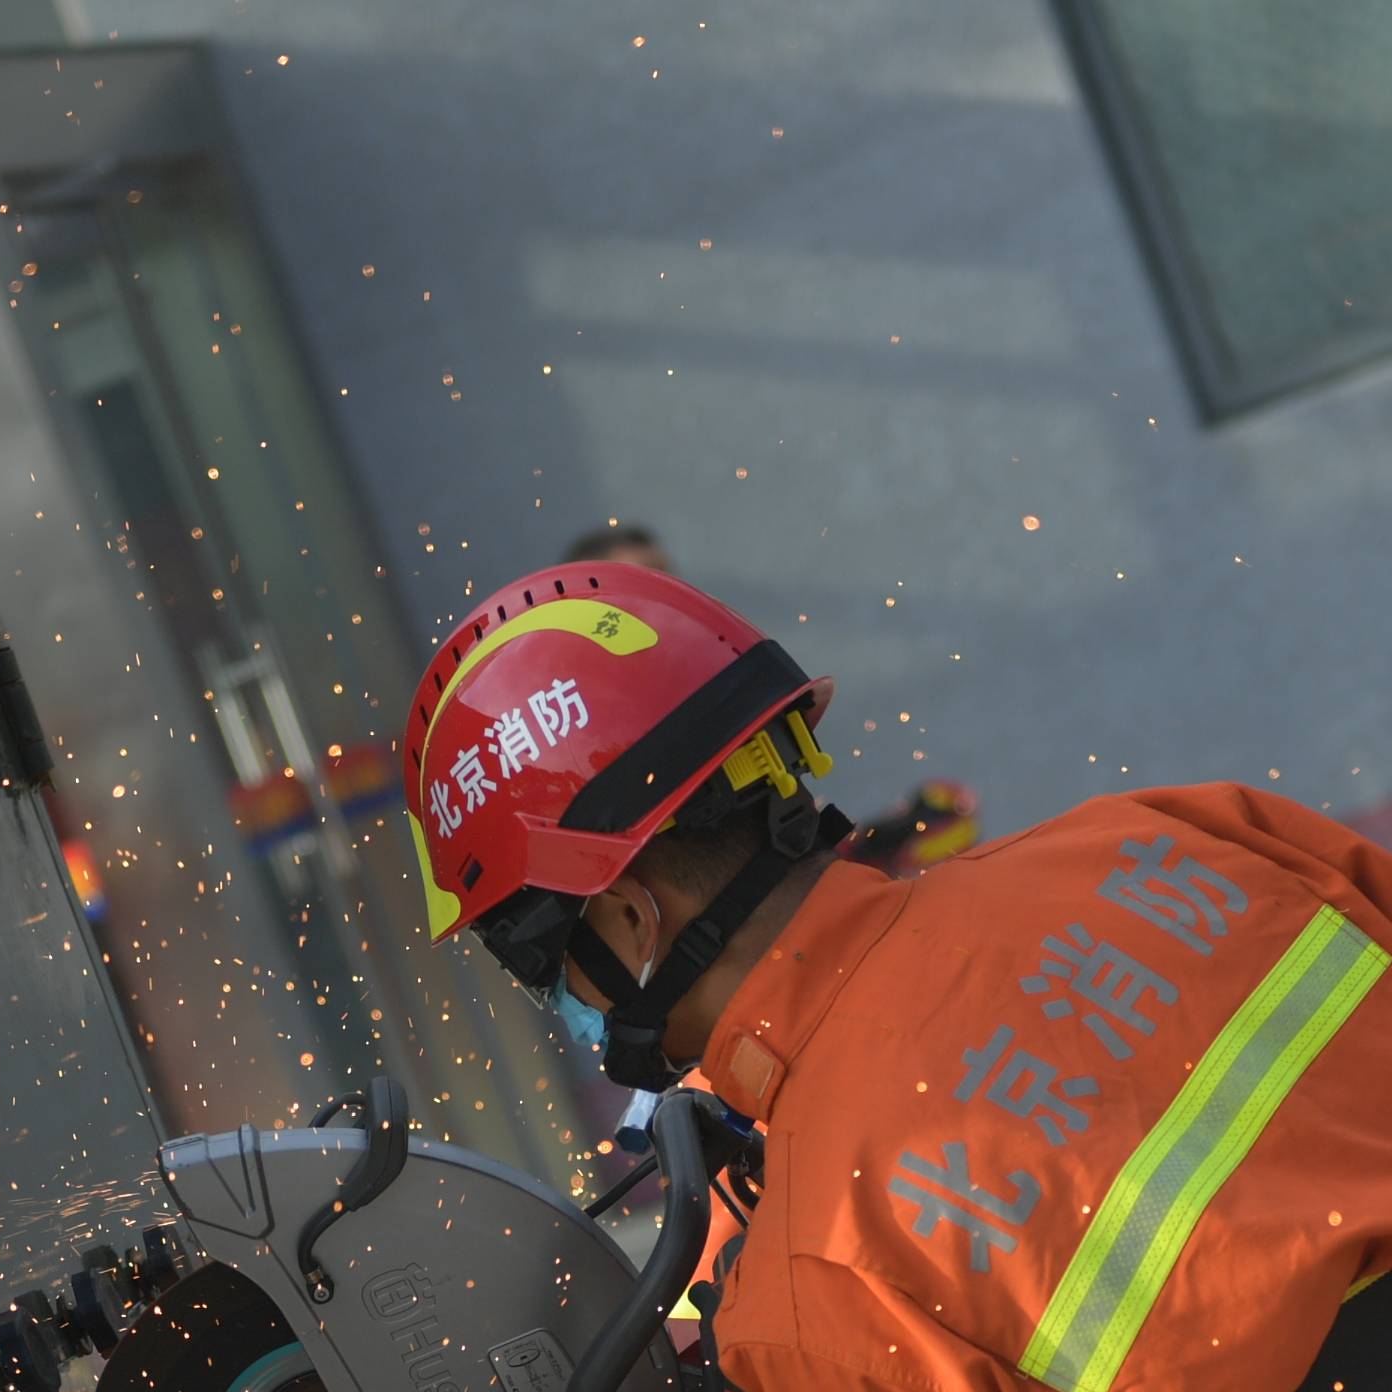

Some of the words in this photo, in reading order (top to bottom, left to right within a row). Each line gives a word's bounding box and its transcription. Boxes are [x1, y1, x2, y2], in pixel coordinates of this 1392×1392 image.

[430, 678, 590, 839] 北京消防
[887, 834, 1249, 1272] 北京消防
